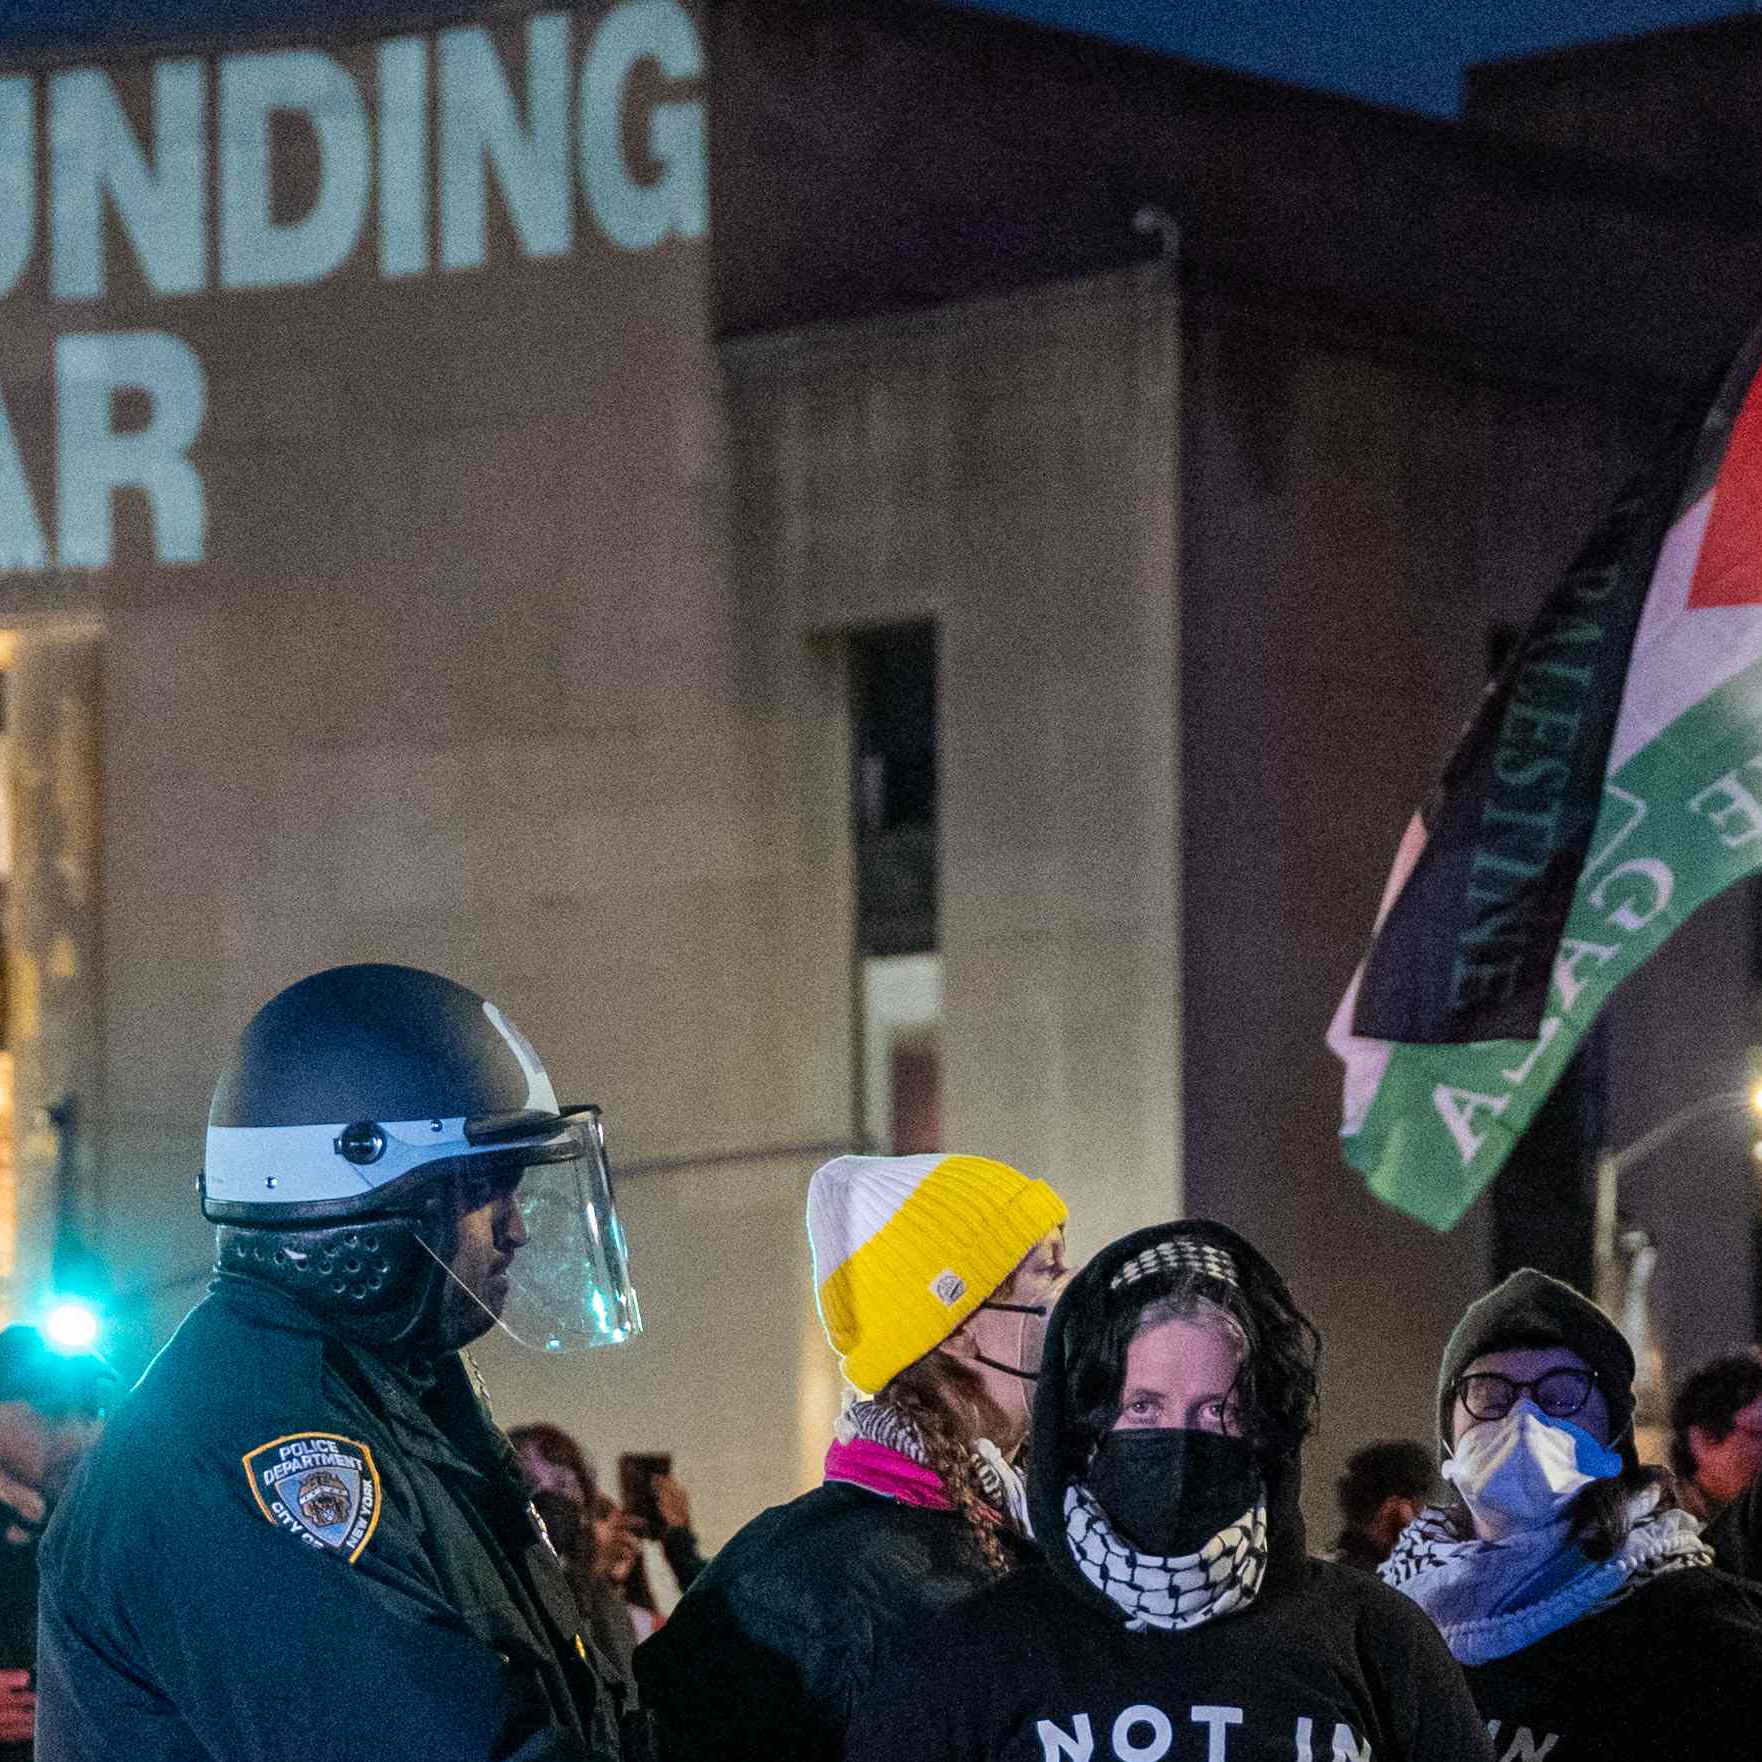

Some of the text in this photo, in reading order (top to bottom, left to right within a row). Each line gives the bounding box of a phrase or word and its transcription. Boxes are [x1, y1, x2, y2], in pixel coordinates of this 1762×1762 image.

[1451, 558, 1627, 1004] PALESTINE
[279, 1439, 340, 1462] POLICE
[263, 1453, 363, 1486] DEPARTMENT
[271, 1501, 304, 1533] CITY
[346, 1479, 374, 1549] NEW YORK
